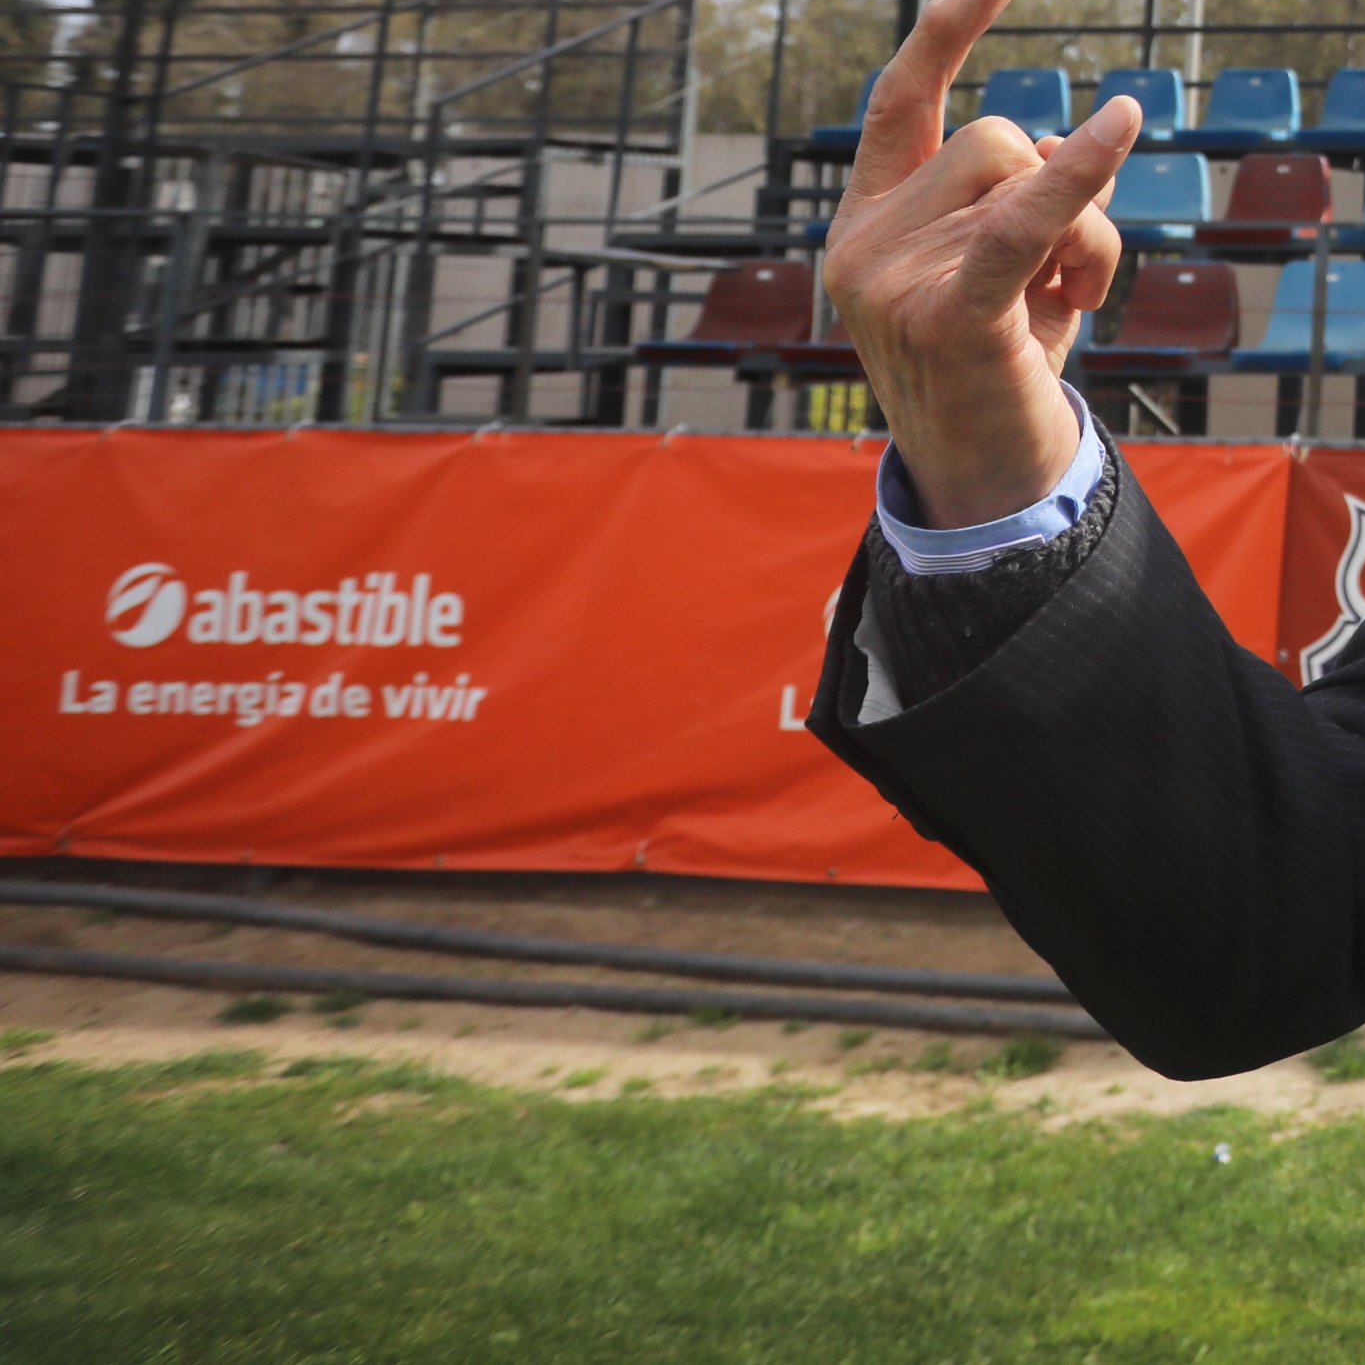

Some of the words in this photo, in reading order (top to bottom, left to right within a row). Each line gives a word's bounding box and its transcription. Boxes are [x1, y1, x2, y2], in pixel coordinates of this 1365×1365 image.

[187, 571, 464, 647] abastible
[58, 669, 118, 714] La
[126, 670, 304, 727] energía
[309, 672, 371, 718] de
[381, 672, 487, 722] vivir
[779, 685, 815, 730] L
